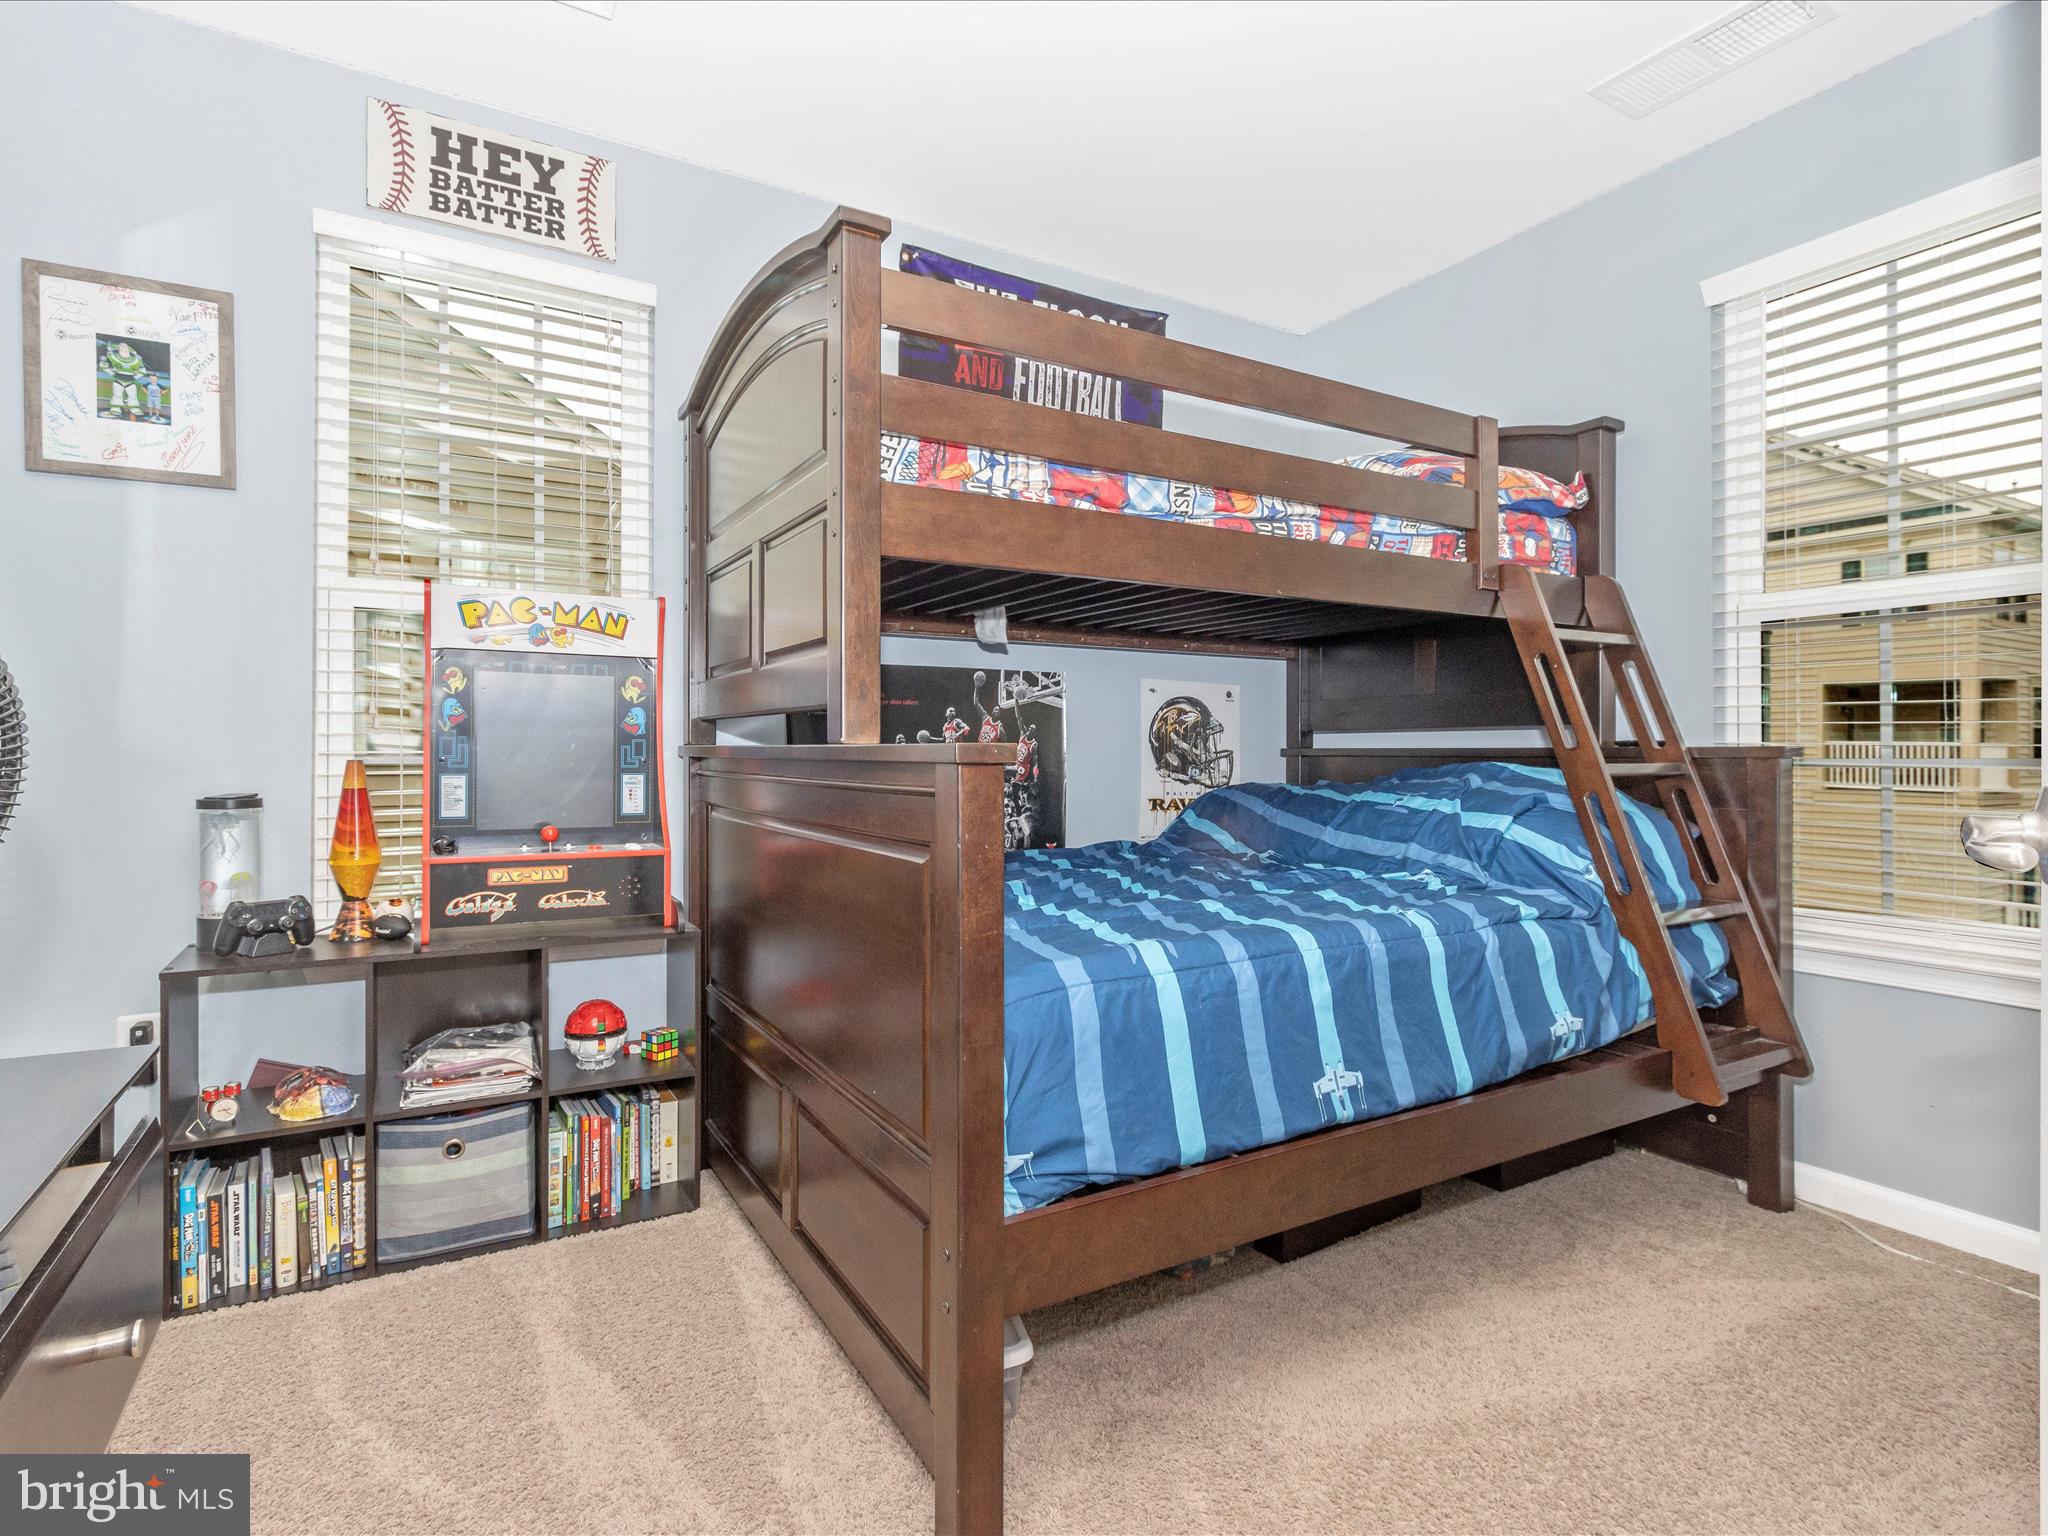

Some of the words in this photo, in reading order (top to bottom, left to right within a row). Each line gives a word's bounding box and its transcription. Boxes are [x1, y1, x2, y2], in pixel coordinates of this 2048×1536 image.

[431, 125, 565, 195] HEY
[429, 167, 566, 220] BATTER
[429, 190, 566, 241] BATTER
[953, 353, 1004, 391] AND
[1012, 356, 1122, 423] FOOTBALL
[456, 595, 630, 641] PAC-MAN
[343, 1180, 351, 1195] DOG
[210, 1200, 220, 1223] STAR
[233, 1190, 241, 1213] STAR
[342, 1195, 351, 1208] MAN
[184, 1213, 194, 1227] DOG
[233, 1213, 241, 1237] WARS
[184, 1227, 194, 1241] MAN
[210, 1223, 220, 1248] WARS
